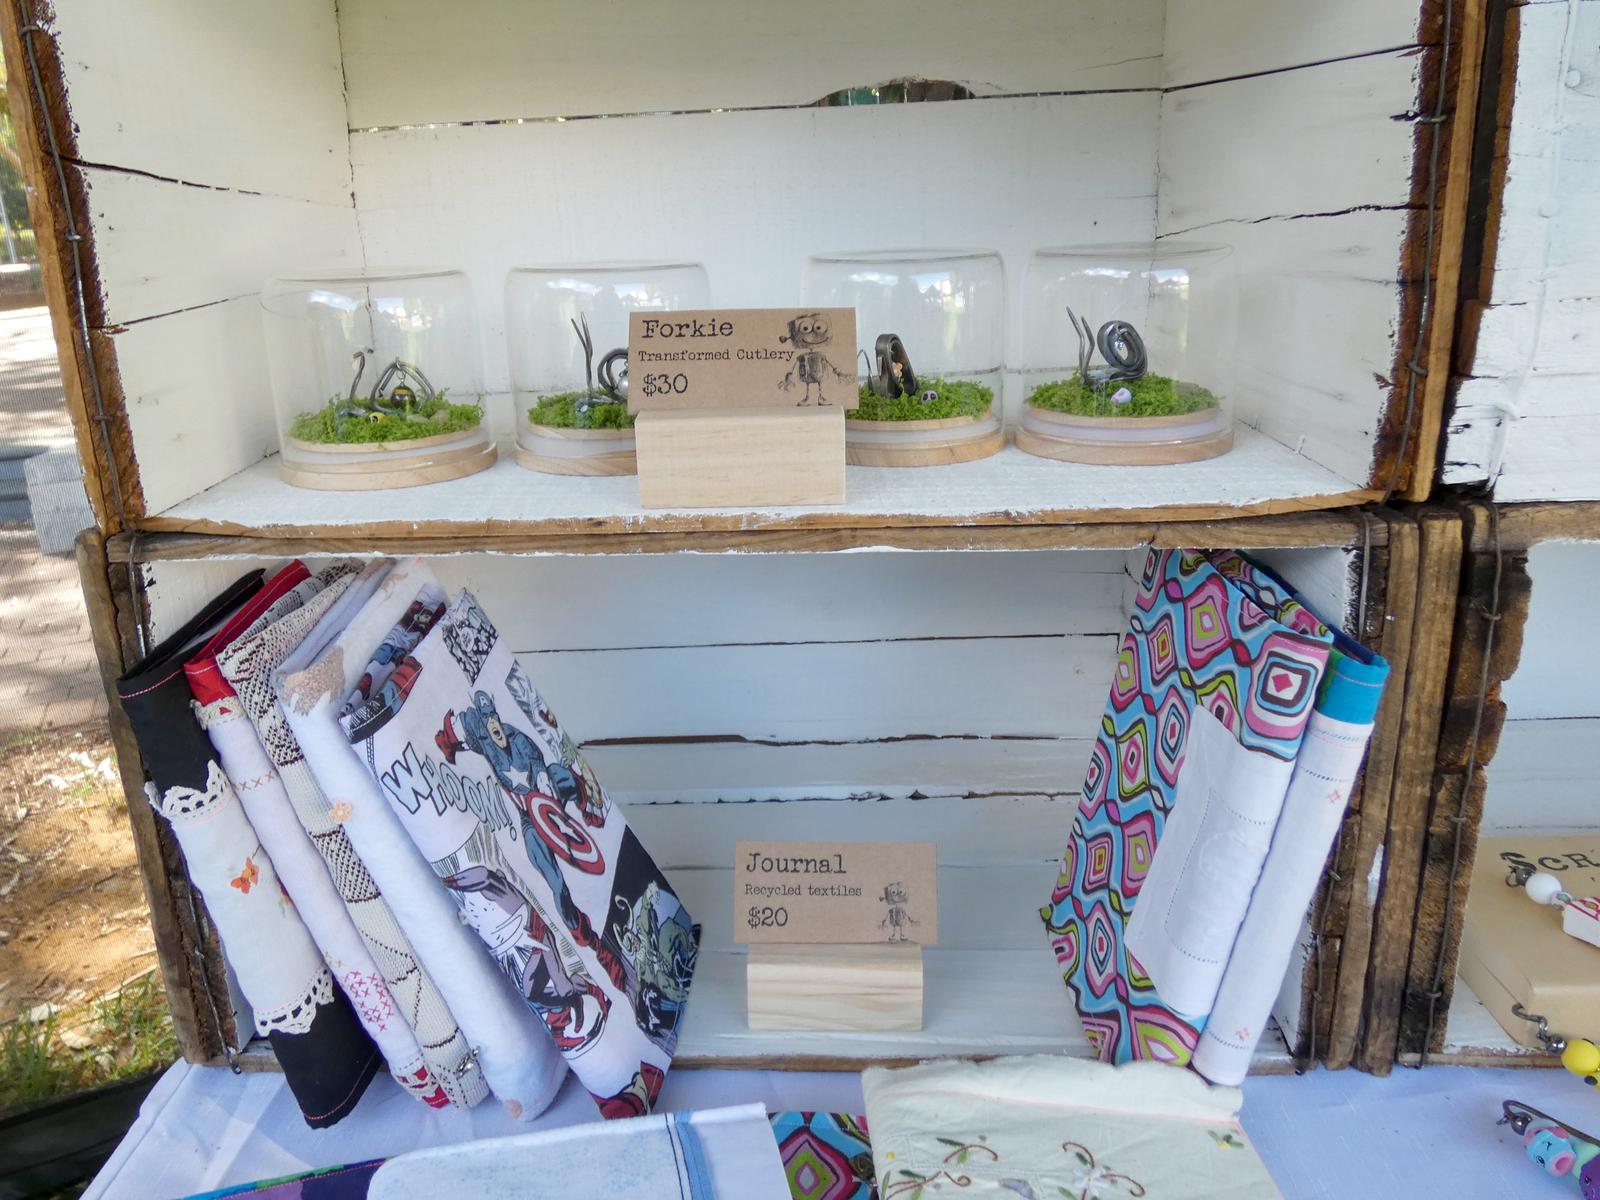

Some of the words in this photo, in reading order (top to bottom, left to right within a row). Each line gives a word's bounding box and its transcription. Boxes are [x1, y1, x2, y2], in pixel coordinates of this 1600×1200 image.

[641, 318, 734, 338] Forkie
[638, 349, 731, 361] Transformed
[736, 349, 794, 361] Cutlery
[642, 373, 688, 397] $30
[746, 853, 847, 874] Journal
[744, 884, 801, 898] Recycled
[807, 885, 862, 897] textiles
[747, 906, 788, 929] $20
